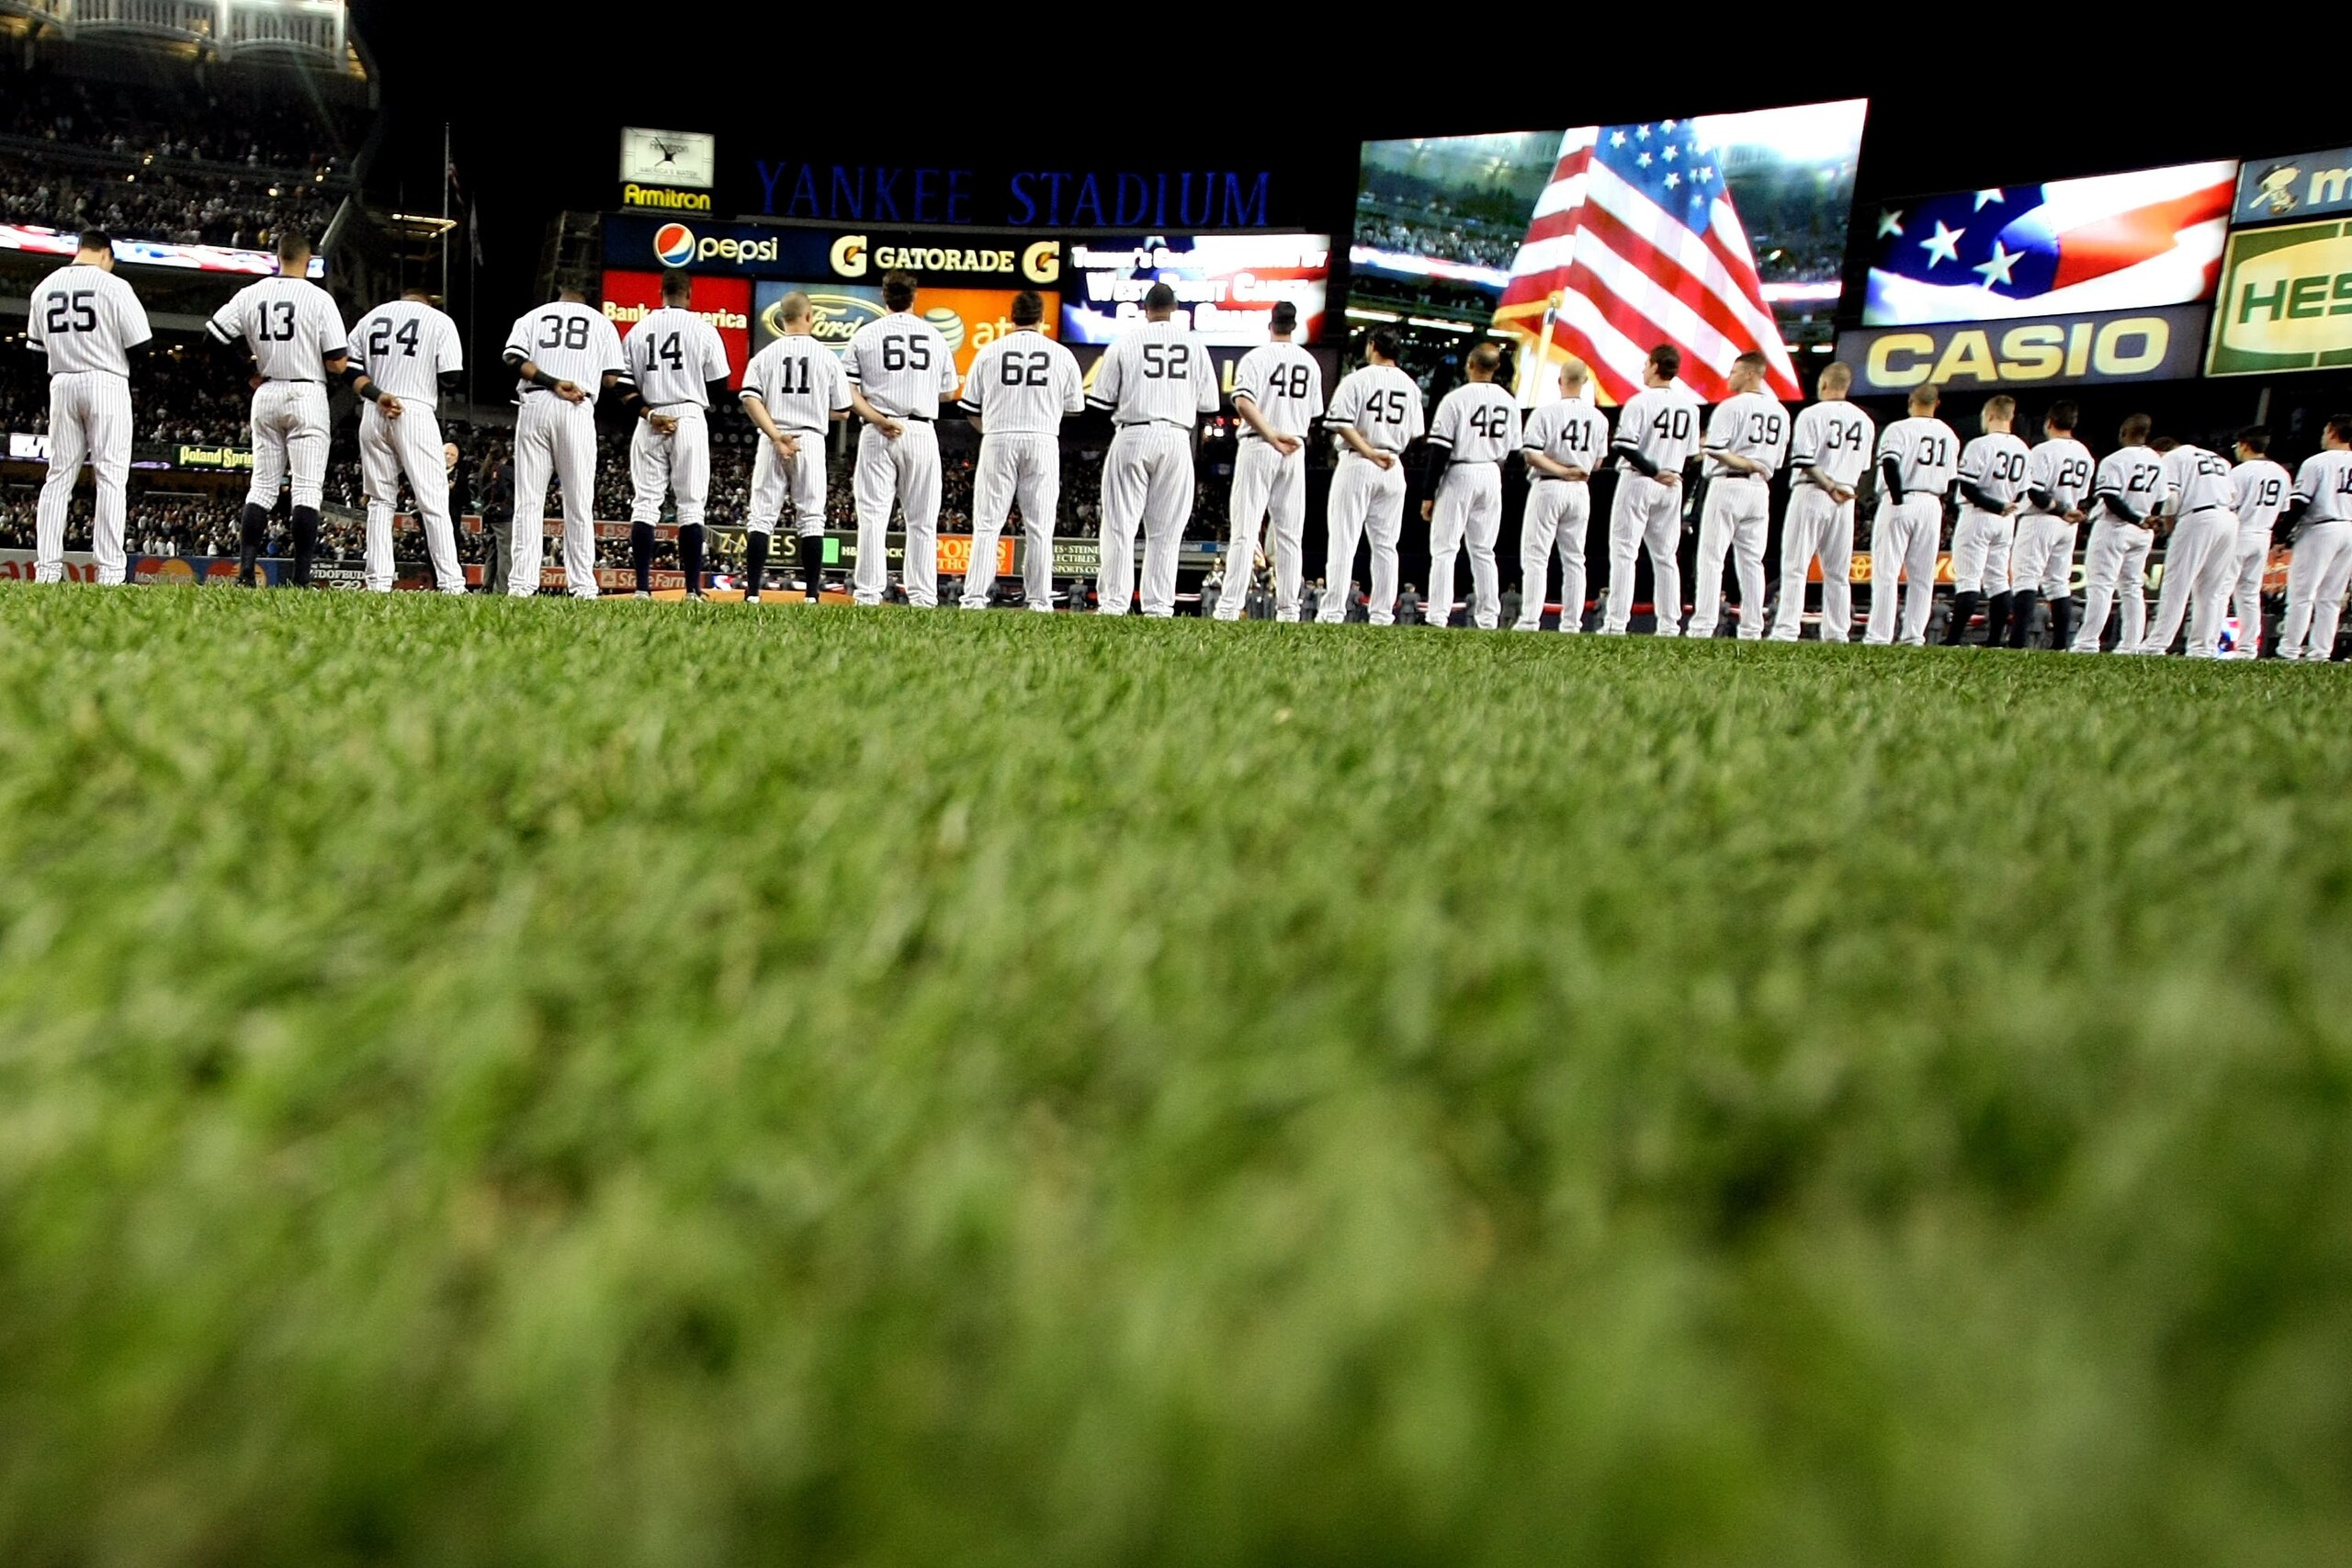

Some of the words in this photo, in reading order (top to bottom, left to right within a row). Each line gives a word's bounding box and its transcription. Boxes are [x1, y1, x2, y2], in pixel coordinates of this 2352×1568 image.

[624, 184, 711, 210] Armitron
[753, 160, 972, 224] YANKEE
[1007, 171, 1272, 227] STADIUM
[697, 236, 778, 265] pepsi
[874, 246, 1015, 273] GATORADE
[47, 291, 96, 334] 25
[258, 301, 295, 342] 13
[603, 301, 650, 322] Bank
[690, 308, 748, 329] erica
[369, 317, 419, 356] 24
[538, 314, 590, 350] 38
[645, 332, 684, 372] 14
[882, 334, 931, 371] 65
[1143, 344, 1190, 379] 52
[1868, 317, 2170, 388] CASIO
[782, 356, 809, 394] 11
[1001, 351, 1050, 387] 62
[1269, 363, 1309, 400] 48
[1365, 389, 1406, 425] 45
[1470, 405, 1509, 439] 42
[1561, 419, 1591, 452] 41
[1653, 409, 1690, 441] 40
[1747, 413, 1781, 446] 39
[1826, 420, 1862, 451] 34
[180, 446, 222, 465] Poland
[222, 448, 253, 468] Sprin
[1917, 436, 1946, 467] 31
[1993, 451, 2025, 483] 30
[2058, 458, 2088, 488] 29
[2128, 464, 2160, 493] 27
[2256, 479, 2281, 507] 19
